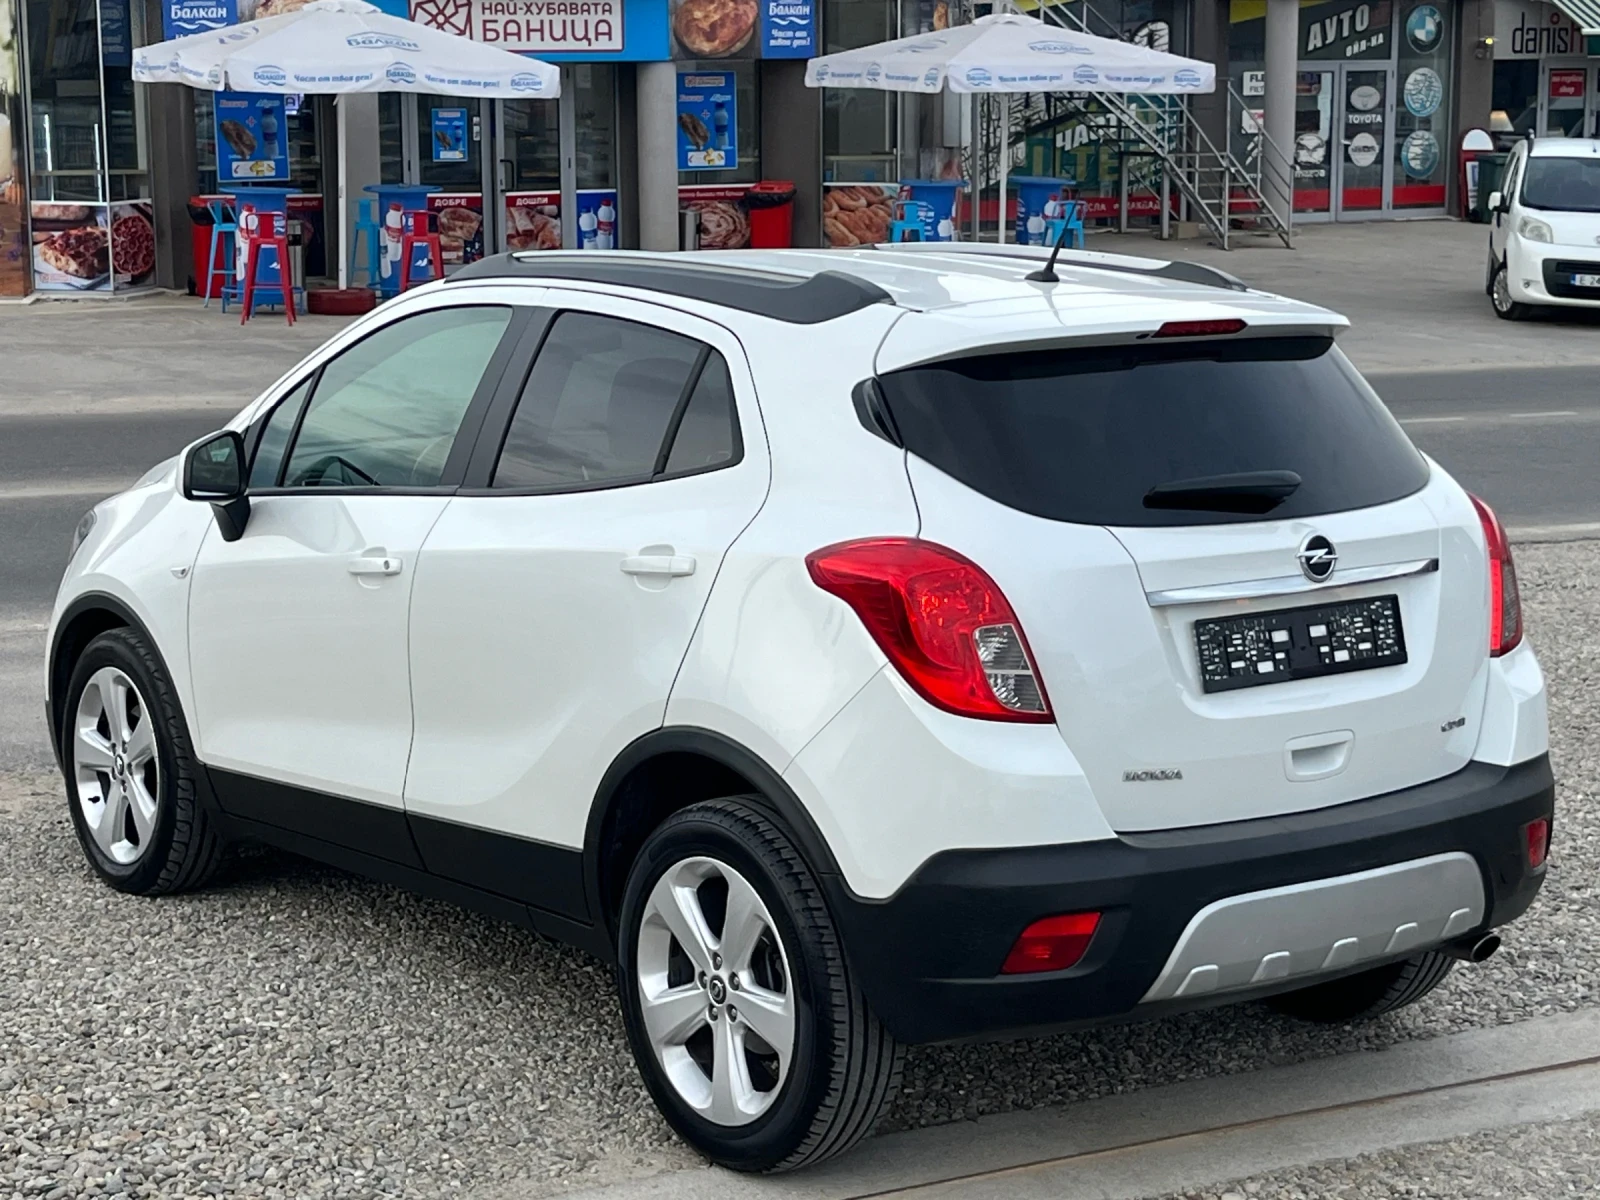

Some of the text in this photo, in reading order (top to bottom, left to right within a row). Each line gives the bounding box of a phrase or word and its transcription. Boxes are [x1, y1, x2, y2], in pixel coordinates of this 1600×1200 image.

[171, 5, 227, 19] Балкан
[481, 0, 612, 15] НАЙ-ХУБАВАТА
[769, 3, 810, 16] Балкан
[482, 19, 612, 46] БАНИЦА
[1512, 12, 1584, 54] danish
[1348, 114, 1383, 123] TOYOTA
[435, 199, 467, 207] ДОБРЕ
[516, 197, 548, 206] ДОШЛИ
